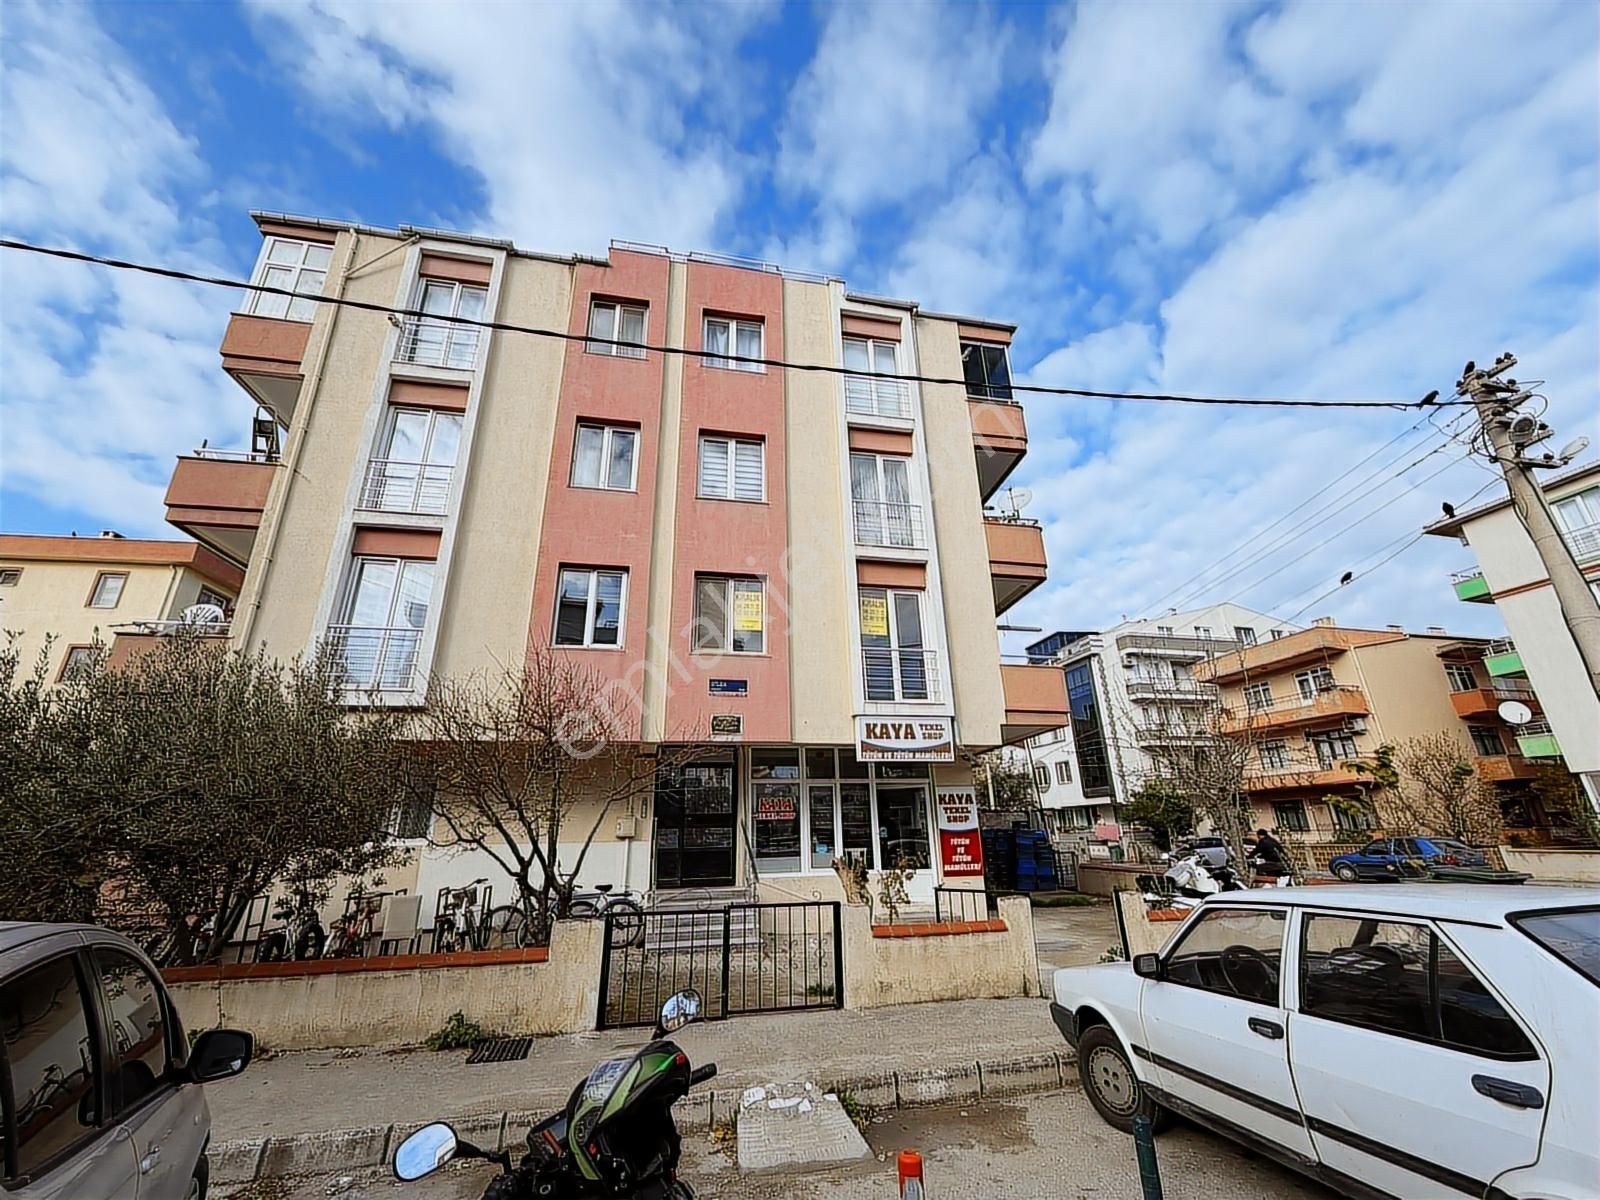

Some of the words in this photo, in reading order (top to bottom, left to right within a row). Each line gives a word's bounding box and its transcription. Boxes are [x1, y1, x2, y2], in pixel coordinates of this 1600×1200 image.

[865, 723, 916, 740] KAYA
[921, 732, 943, 740] SHOP
[938, 793, 974, 804] KAYA
[947, 815, 970, 823] SHOP
